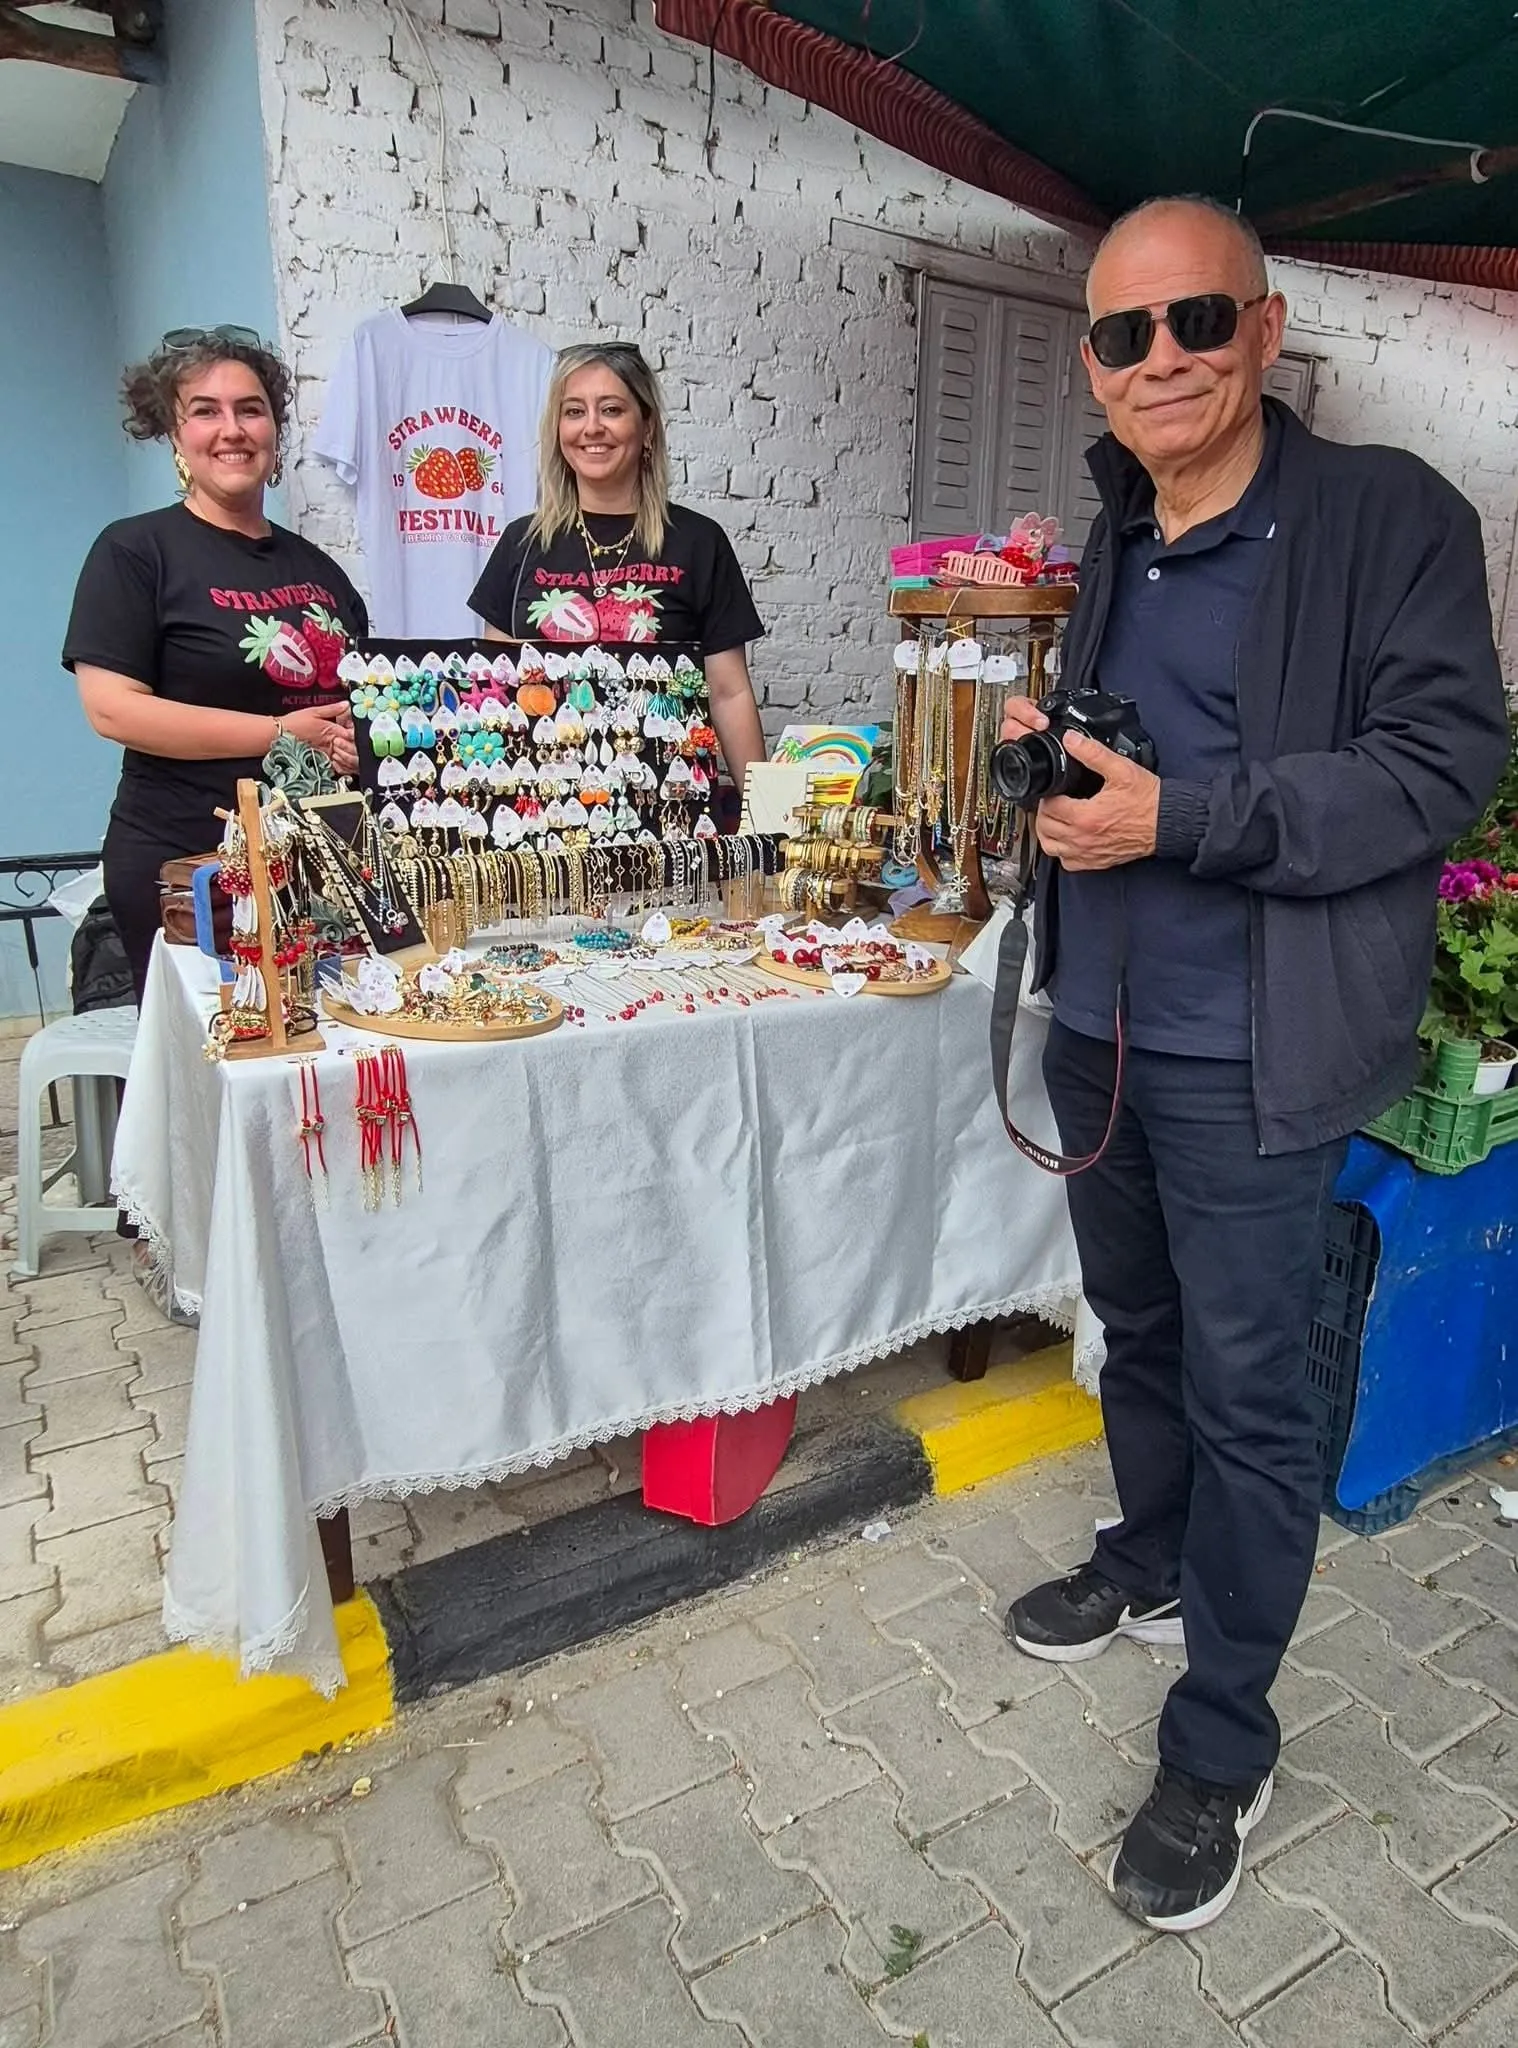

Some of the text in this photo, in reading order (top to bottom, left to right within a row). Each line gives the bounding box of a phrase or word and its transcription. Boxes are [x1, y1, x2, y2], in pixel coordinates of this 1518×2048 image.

[388, 406, 503, 459] STRAWBERR
[392, 473, 404, 487] 19
[399, 509, 502, 536] FESTIVAL
